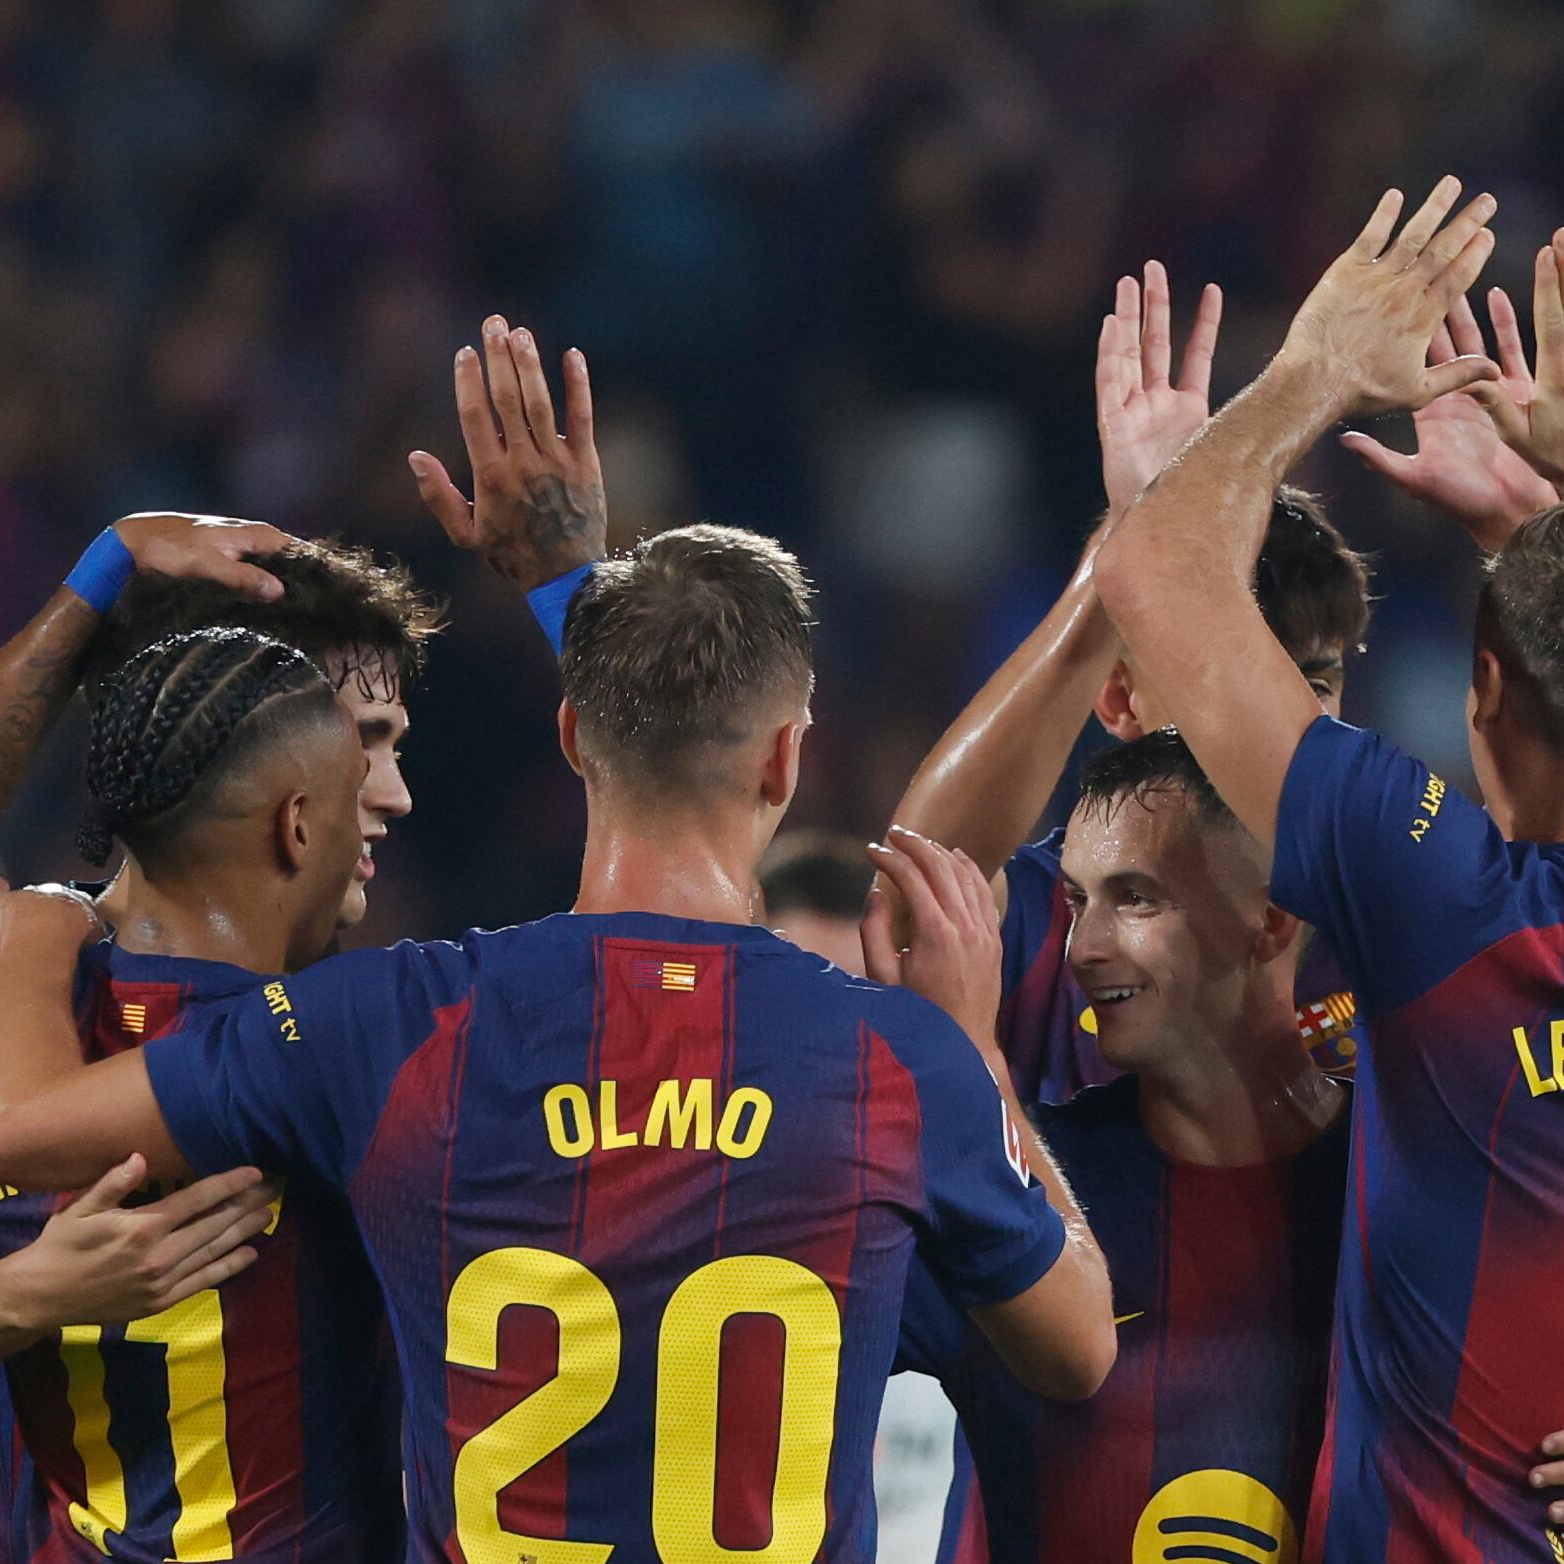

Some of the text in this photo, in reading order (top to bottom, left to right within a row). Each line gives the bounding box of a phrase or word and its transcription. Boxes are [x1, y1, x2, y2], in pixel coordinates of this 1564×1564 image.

[1409, 818, 1431, 843] tv
[280, 1017, 302, 1042] tv
[542, 1078, 774, 1160] OLMO
[57, 1288, 238, 1564] 11
